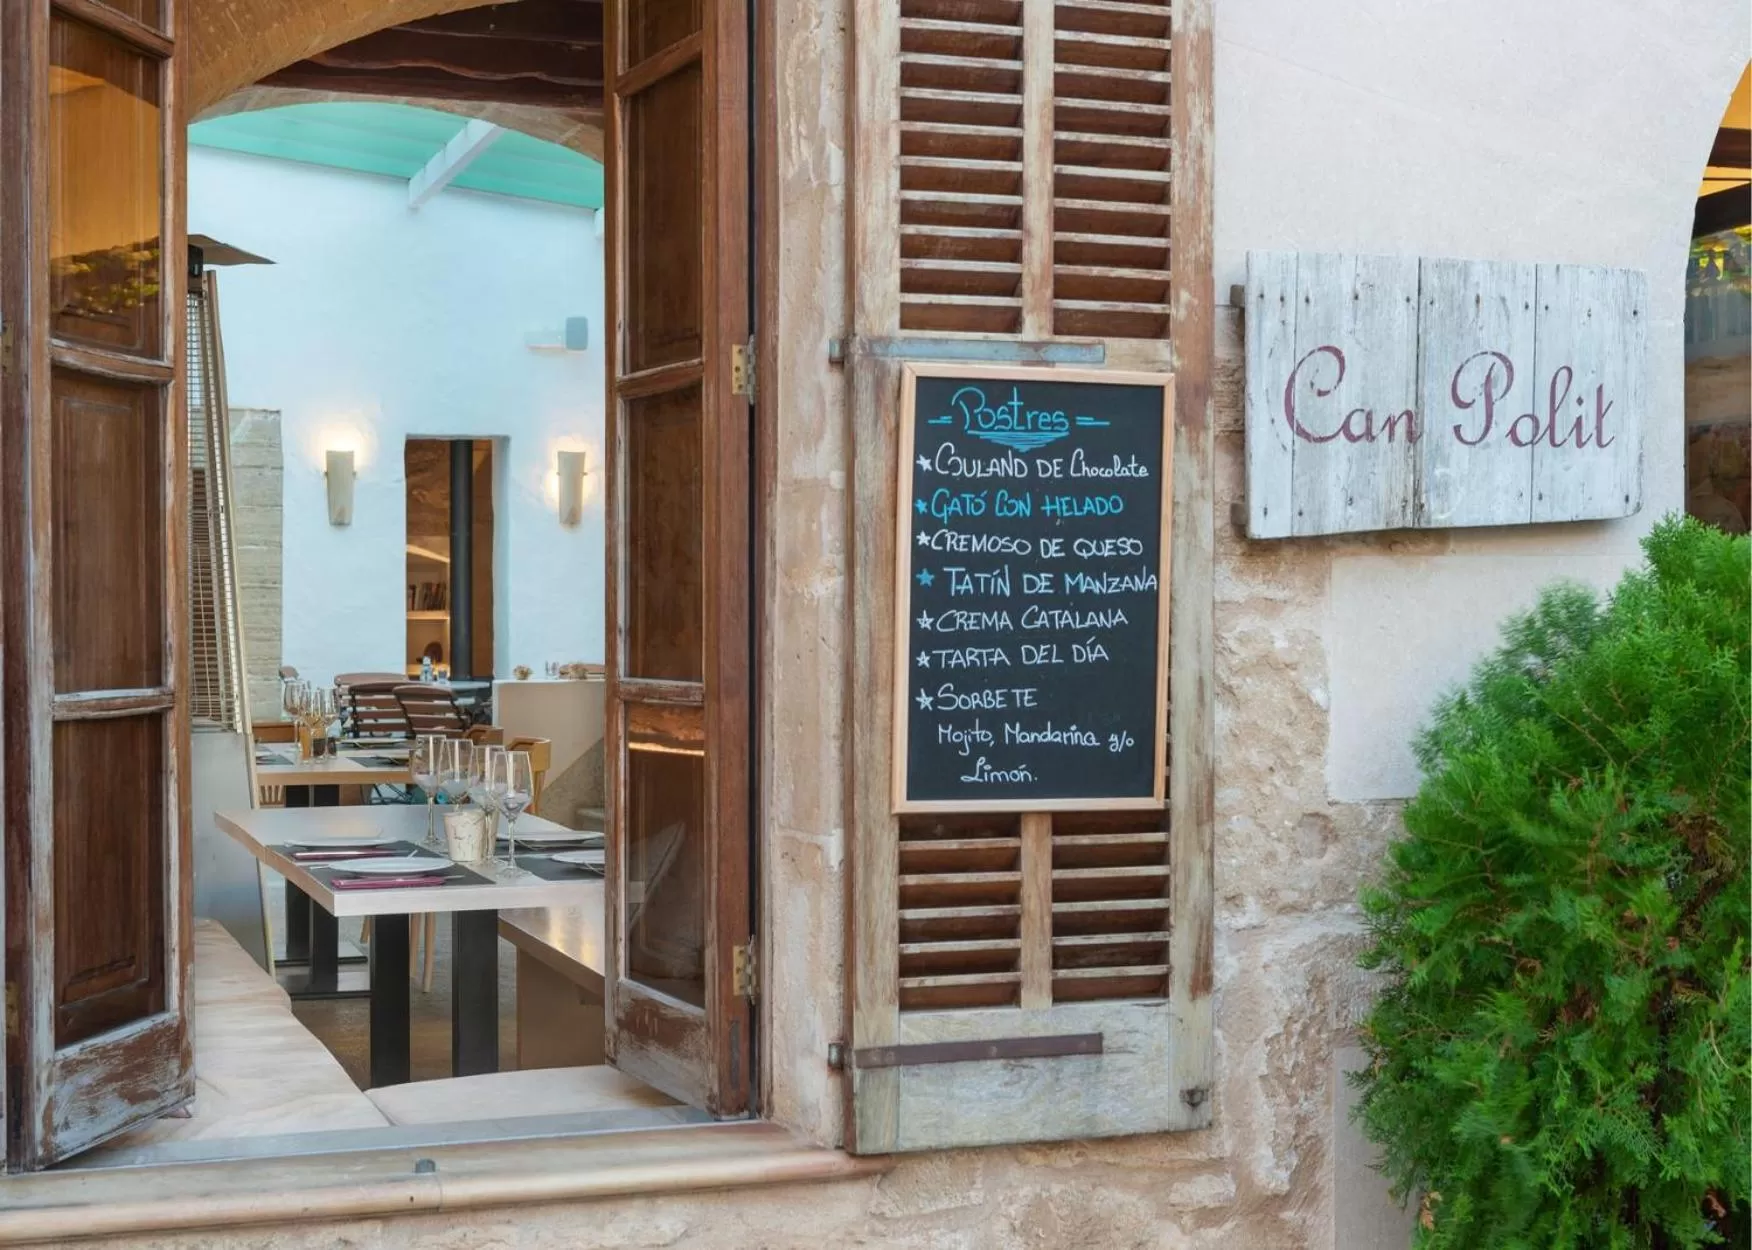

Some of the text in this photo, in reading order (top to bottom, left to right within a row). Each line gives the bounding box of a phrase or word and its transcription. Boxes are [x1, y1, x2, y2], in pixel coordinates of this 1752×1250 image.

[951, 386, 1070, 431] Postres
[1284, 345, 1615, 449] Can Polit
[935, 442, 1149, 478] COULAND DE Chocolate
[931, 488, 1124, 524] GATÓ CON HELADO
[931, 528, 1144, 559] CREMOSO DE QUESO
[943, 564, 1158, 597] TATÍN DE MANZANA
[936, 605, 1128, 632] CREMA CATALANA
[932, 636, 1109, 669] TARTA DEL DÍA
[937, 683, 1037, 710] SORBETE
[938, 718, 994, 756] Mojito,
[1004, 722, 1100, 747] Mandarina
[960, 757, 1037, 784] Limón.
